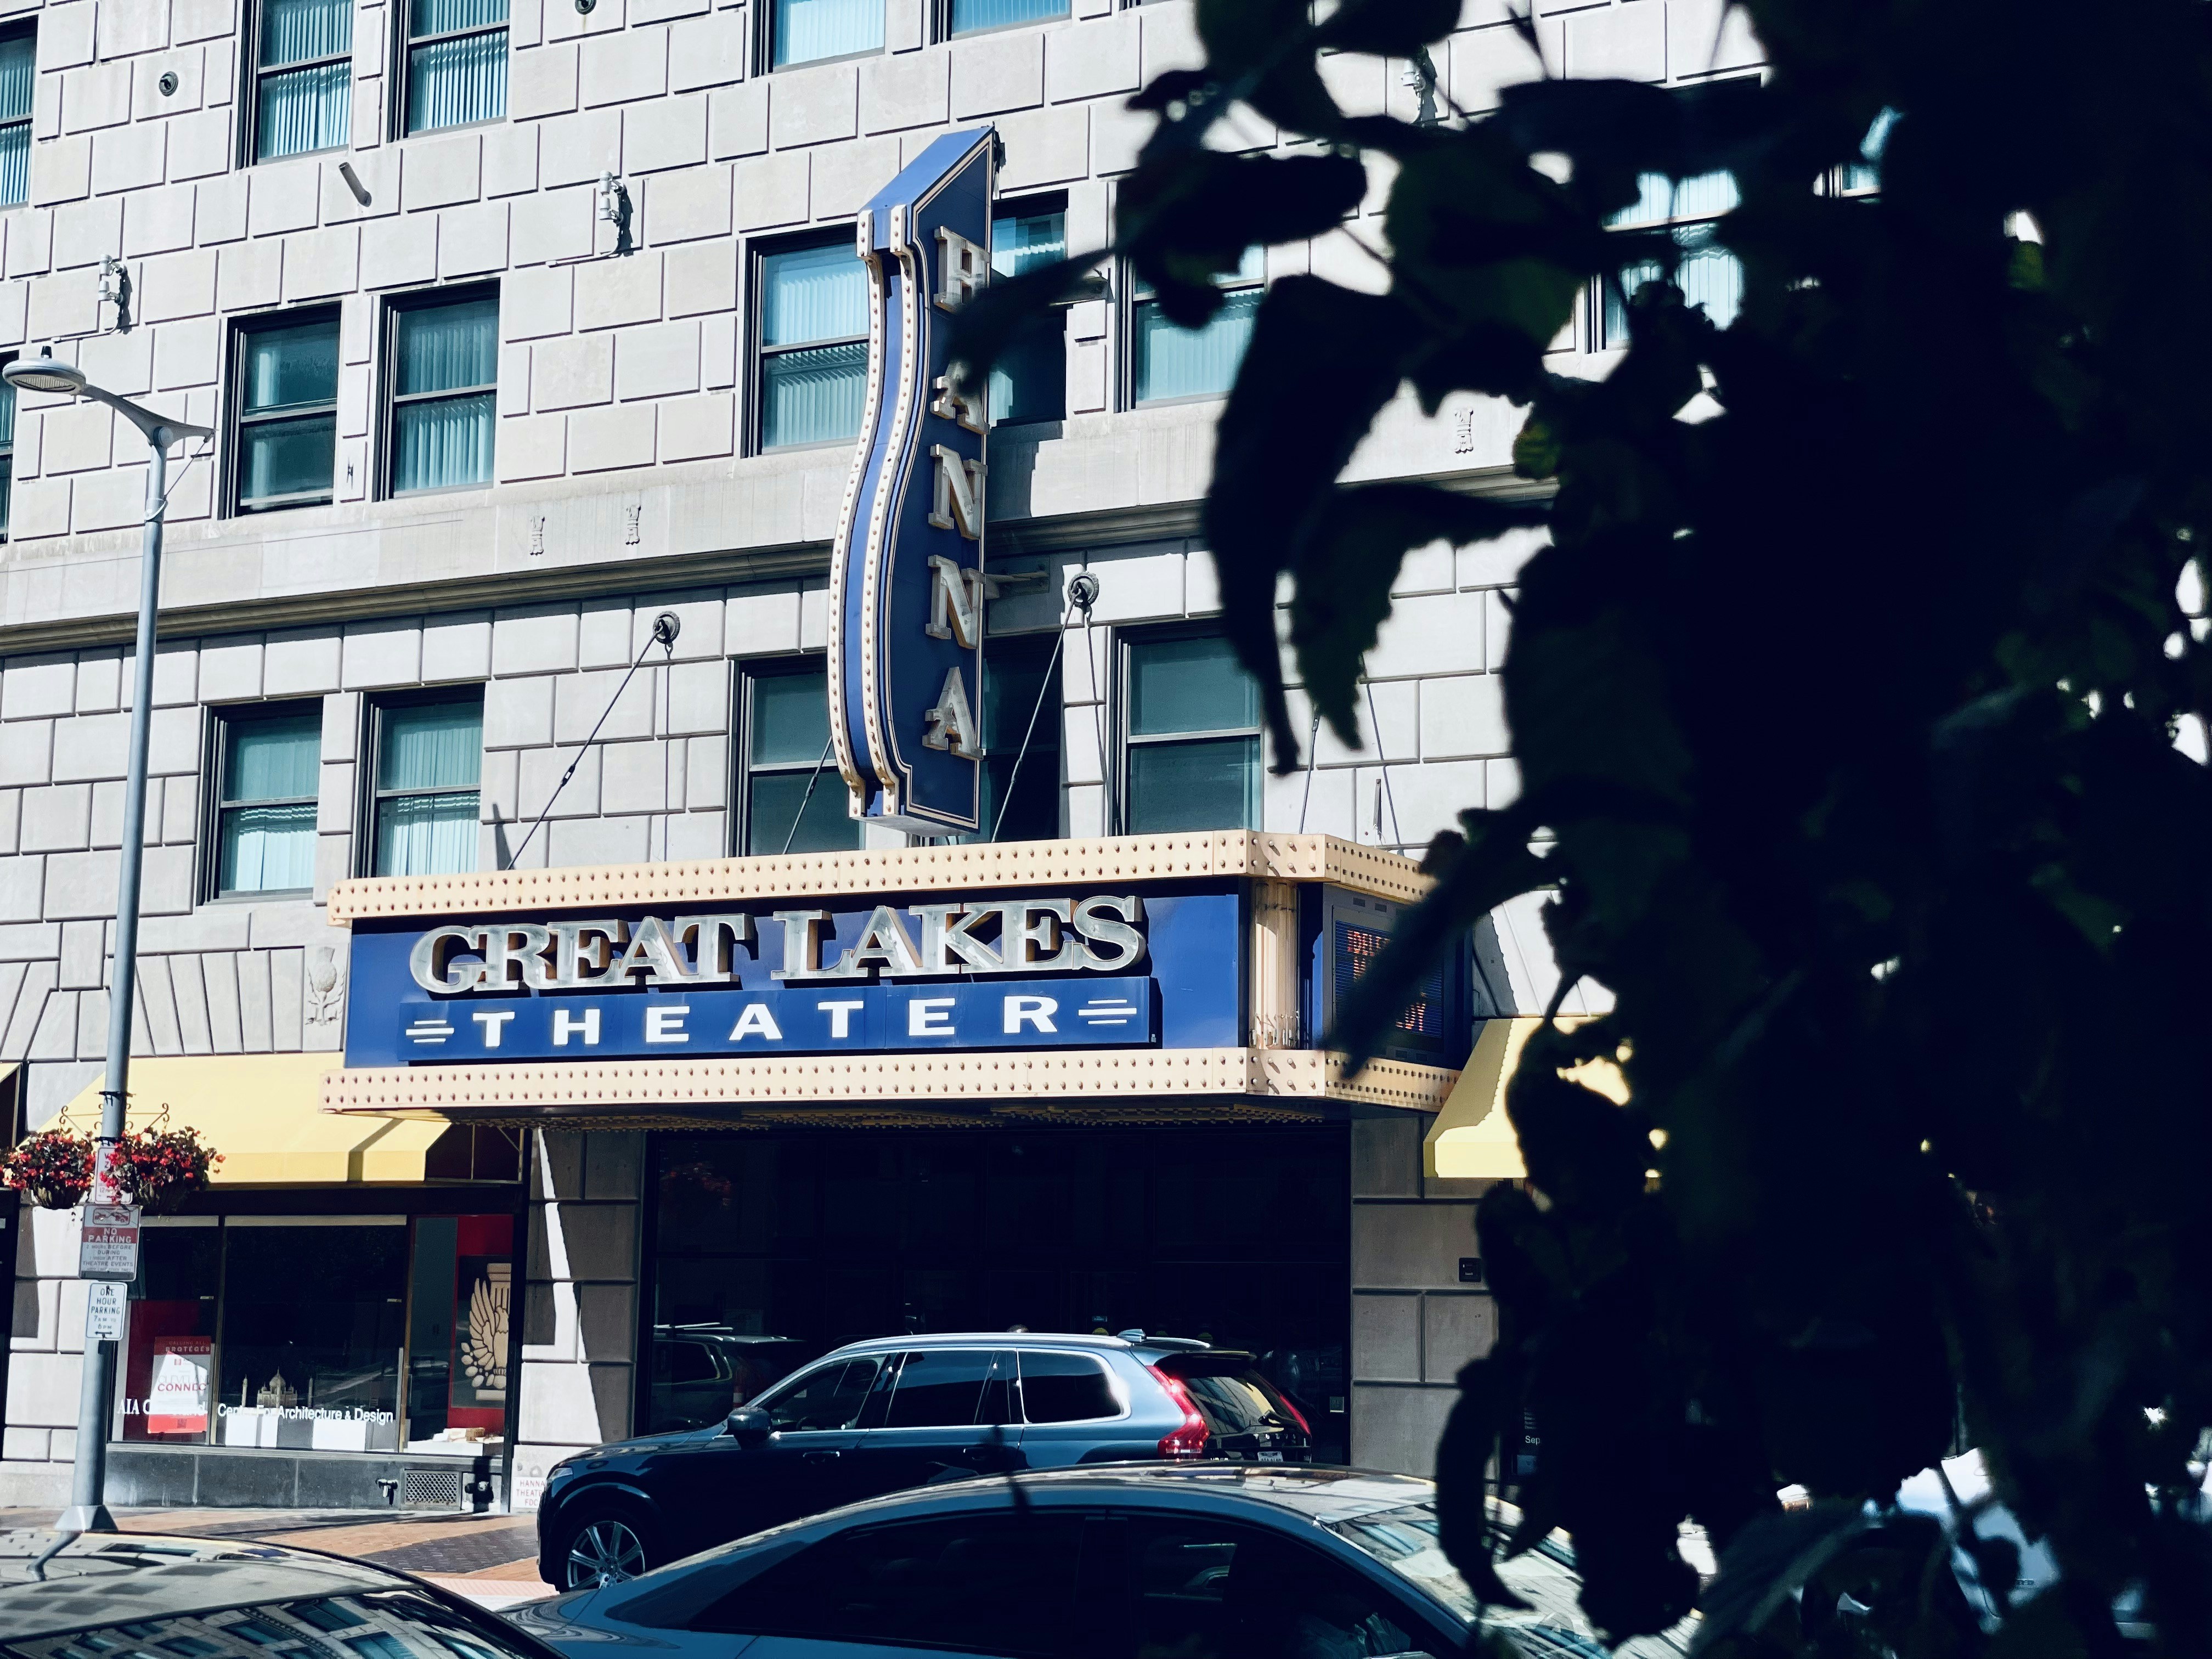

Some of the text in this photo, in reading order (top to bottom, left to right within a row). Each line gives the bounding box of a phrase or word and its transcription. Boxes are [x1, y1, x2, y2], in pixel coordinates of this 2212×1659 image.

[410, 895, 1146, 994] GREAT LAKES
[472, 995, 1059, 1047] THEATER
[88, 1234, 132, 1243] PARKING
[91, 1306, 120, 1314] PARKING
[117, 1398, 140, 1414] AIA
[278, 1406, 342, 1420] Architecture
[344, 1411, 351, 1420] &
[354, 1408, 393, 1425] Design
